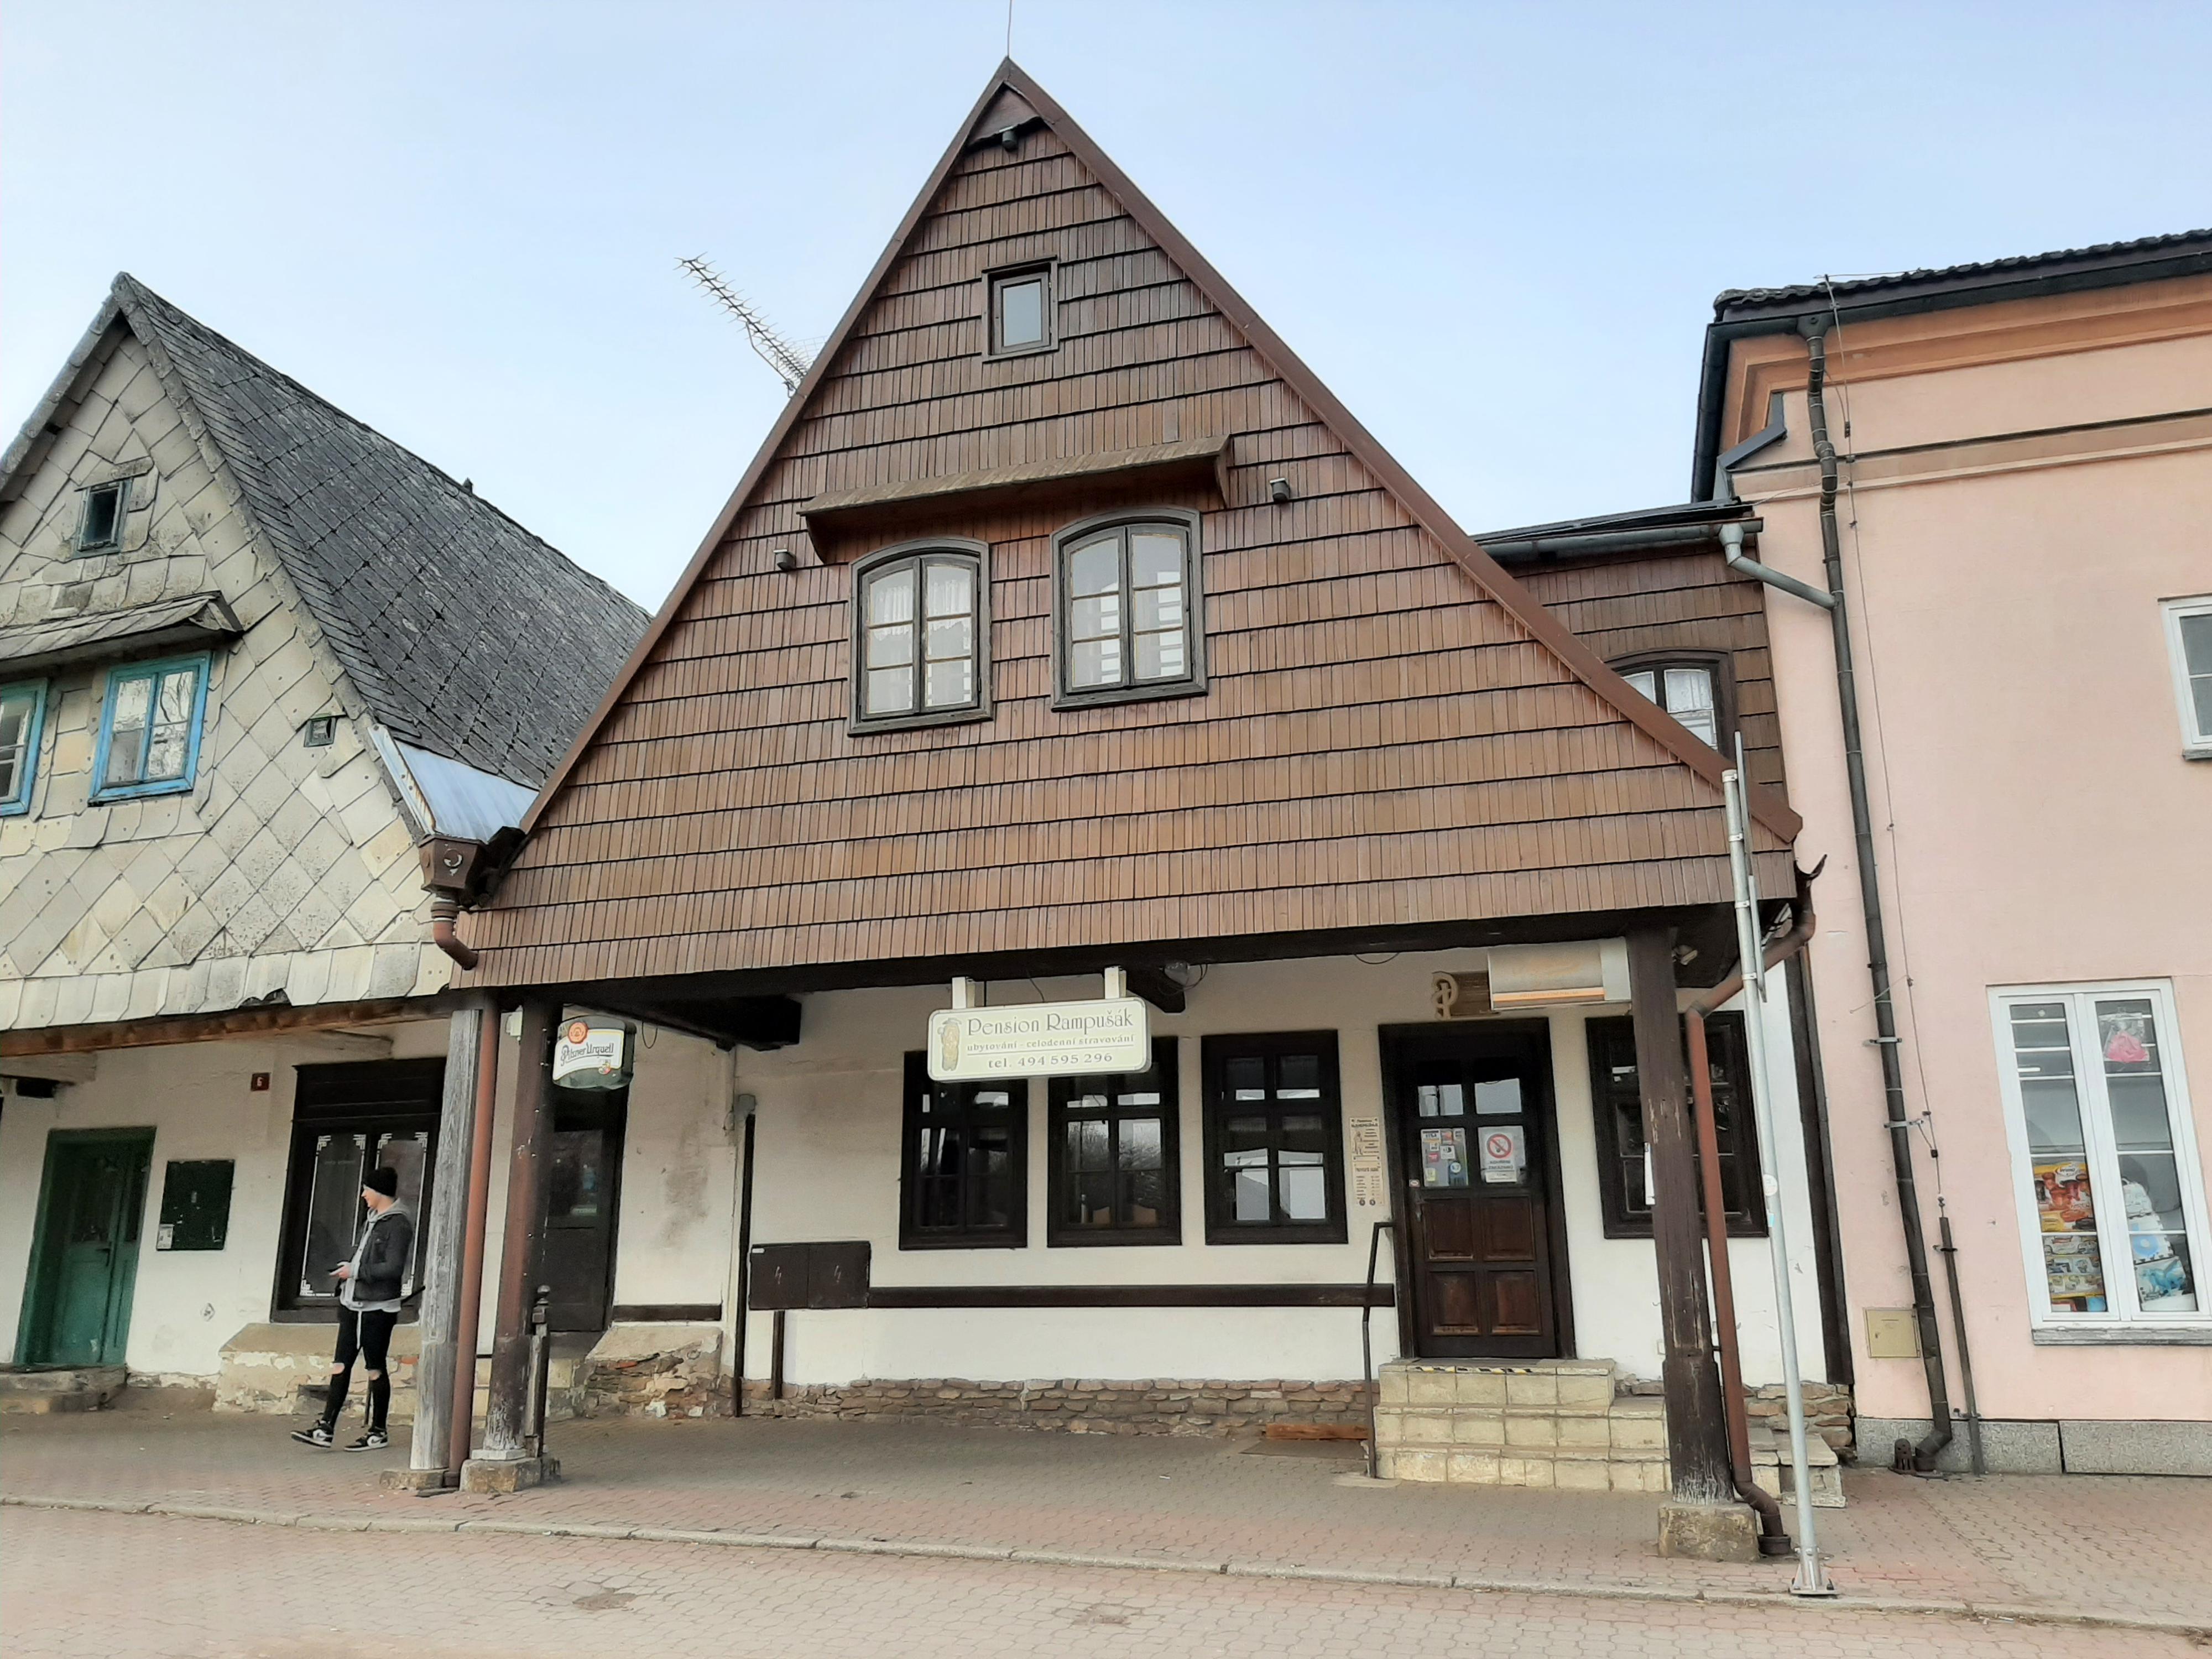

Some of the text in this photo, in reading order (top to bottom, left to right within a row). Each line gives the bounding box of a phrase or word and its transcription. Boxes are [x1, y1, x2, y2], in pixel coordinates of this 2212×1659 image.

[968, 1007, 1134, 1036] Pension Rampušák
[967, 1040, 1018, 1052] ubytování
[1026, 1036, 1076, 1048] celodenní
[1078, 1034, 1134, 1045] stravování
[560, 1042, 614, 1067] Pilsner Urquell
[988, 1052, 1113, 1068] tel. 494 595 296
